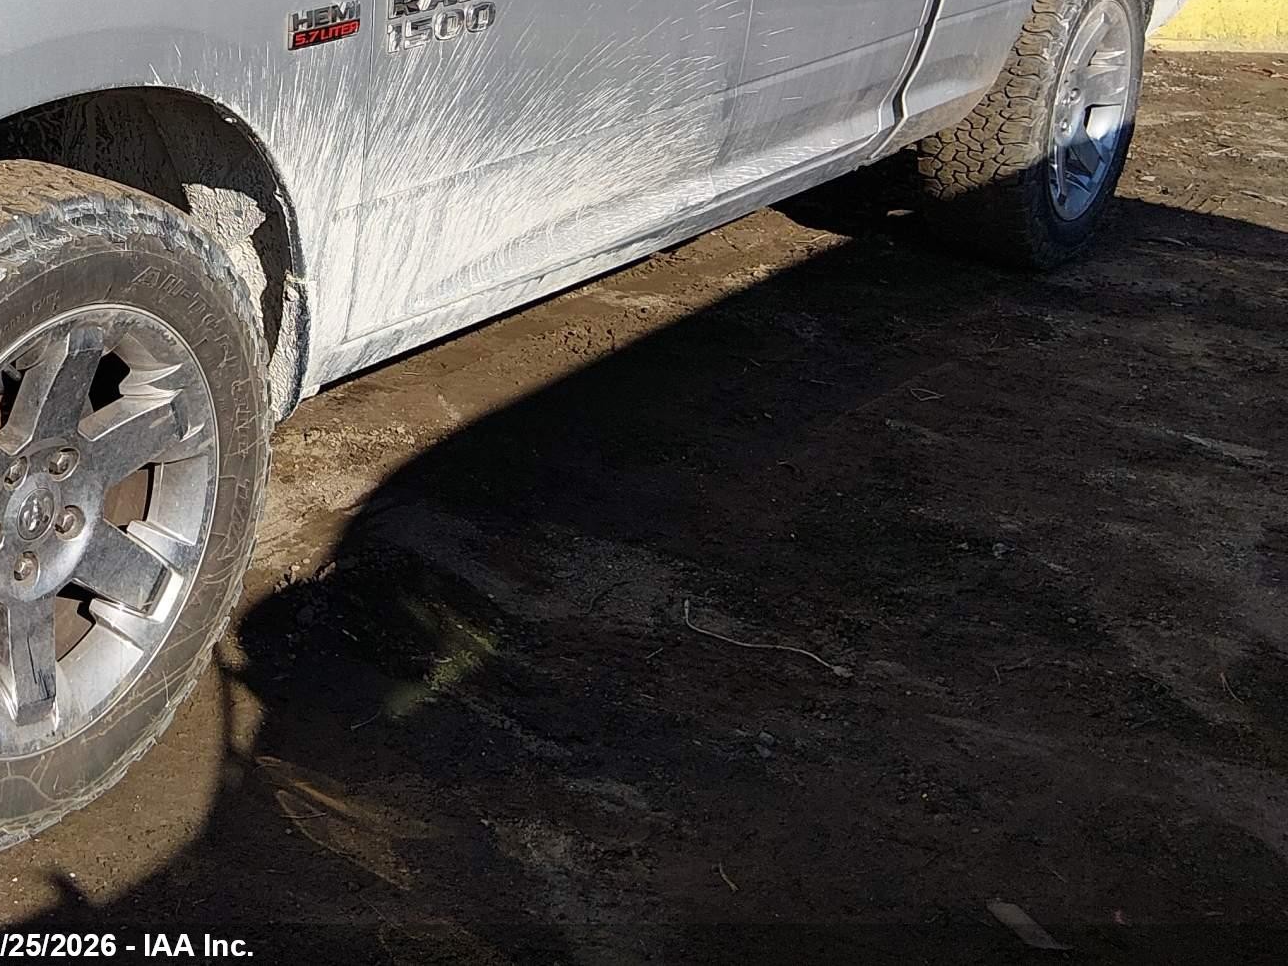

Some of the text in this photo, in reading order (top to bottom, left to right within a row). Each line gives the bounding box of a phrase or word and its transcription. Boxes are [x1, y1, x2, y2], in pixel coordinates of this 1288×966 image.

[294, 22, 360, 47] 5.7 LITER
[386, 2, 497, 53] 1500
